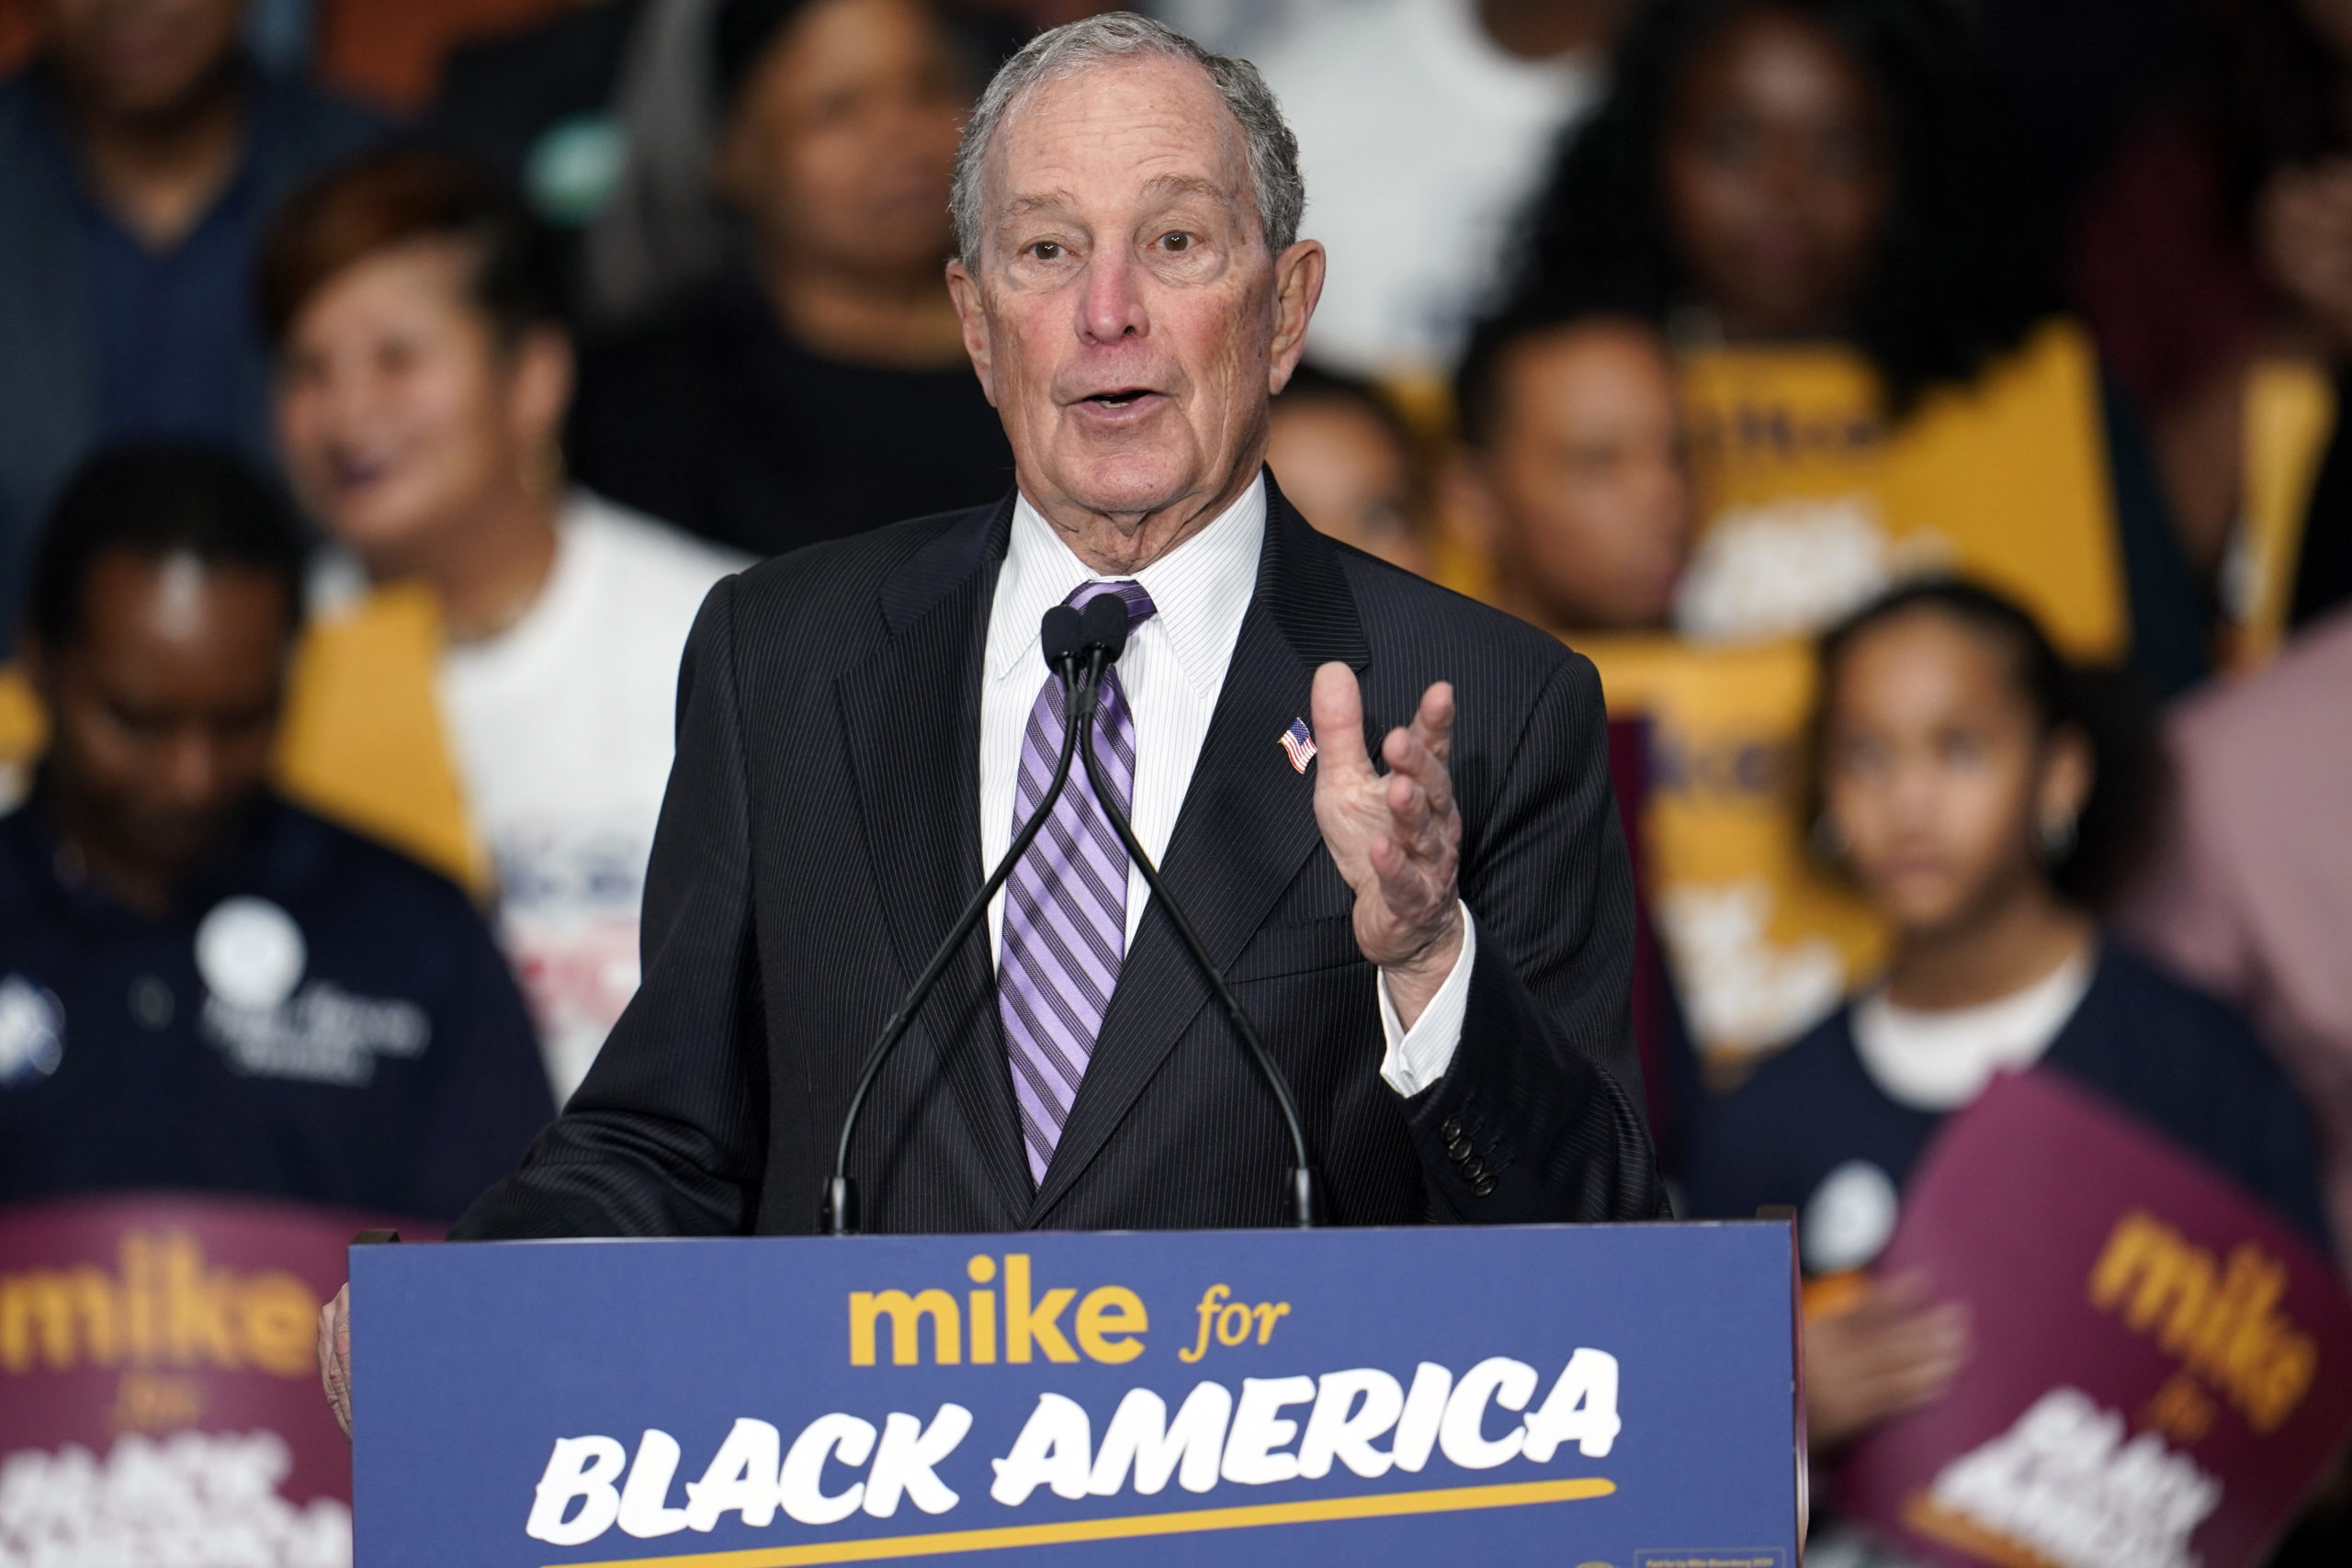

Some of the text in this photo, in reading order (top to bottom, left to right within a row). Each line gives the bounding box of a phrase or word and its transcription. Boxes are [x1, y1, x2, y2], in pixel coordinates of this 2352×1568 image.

[849, 1253, 1291, 1367] mike for
[526, 1403, 973, 1546] BLACK
[989, 1348, 1622, 1506] AMERICA
